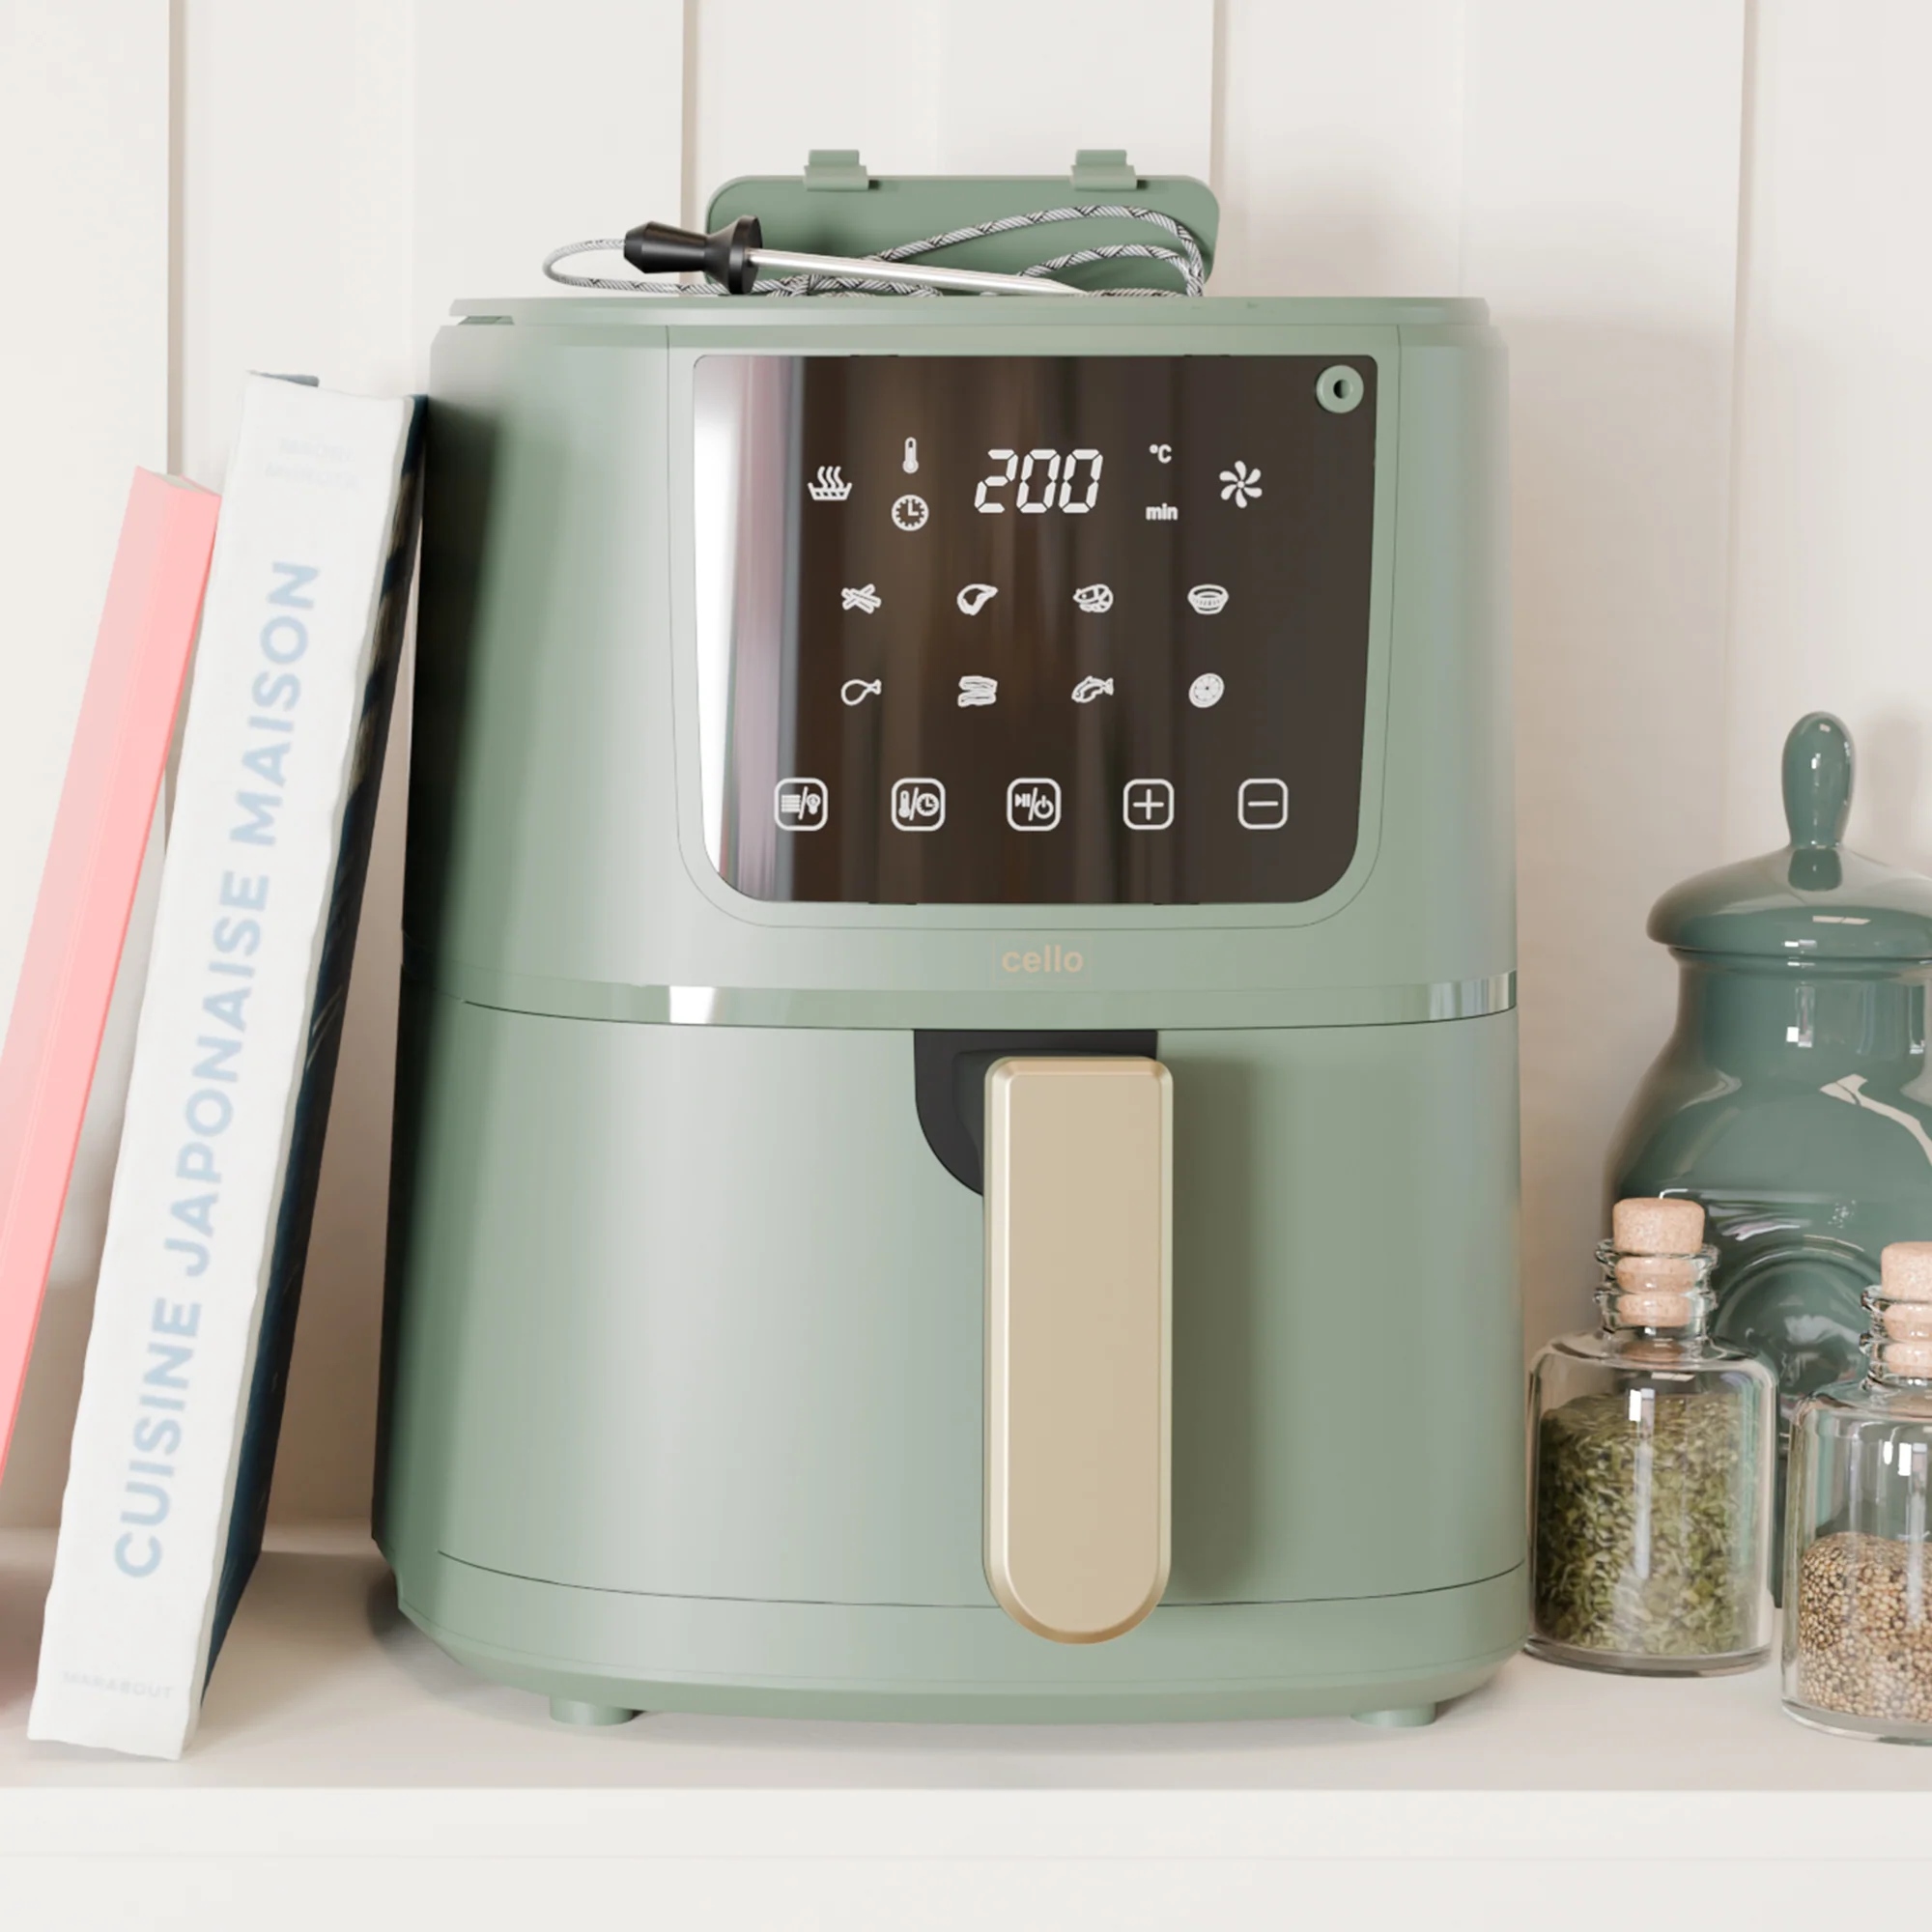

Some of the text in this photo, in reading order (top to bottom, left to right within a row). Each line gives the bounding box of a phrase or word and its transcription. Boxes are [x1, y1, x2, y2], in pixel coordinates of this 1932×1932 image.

[974, 447, 1104, 515] 200
[1145, 502, 1179, 521] min
[1002, 944, 1084, 973] cello
[114, 1297, 200, 1577] CUISINE
[165, 869, 269, 1277] JAPONAISE
[232, 559, 319, 846] MAISON
